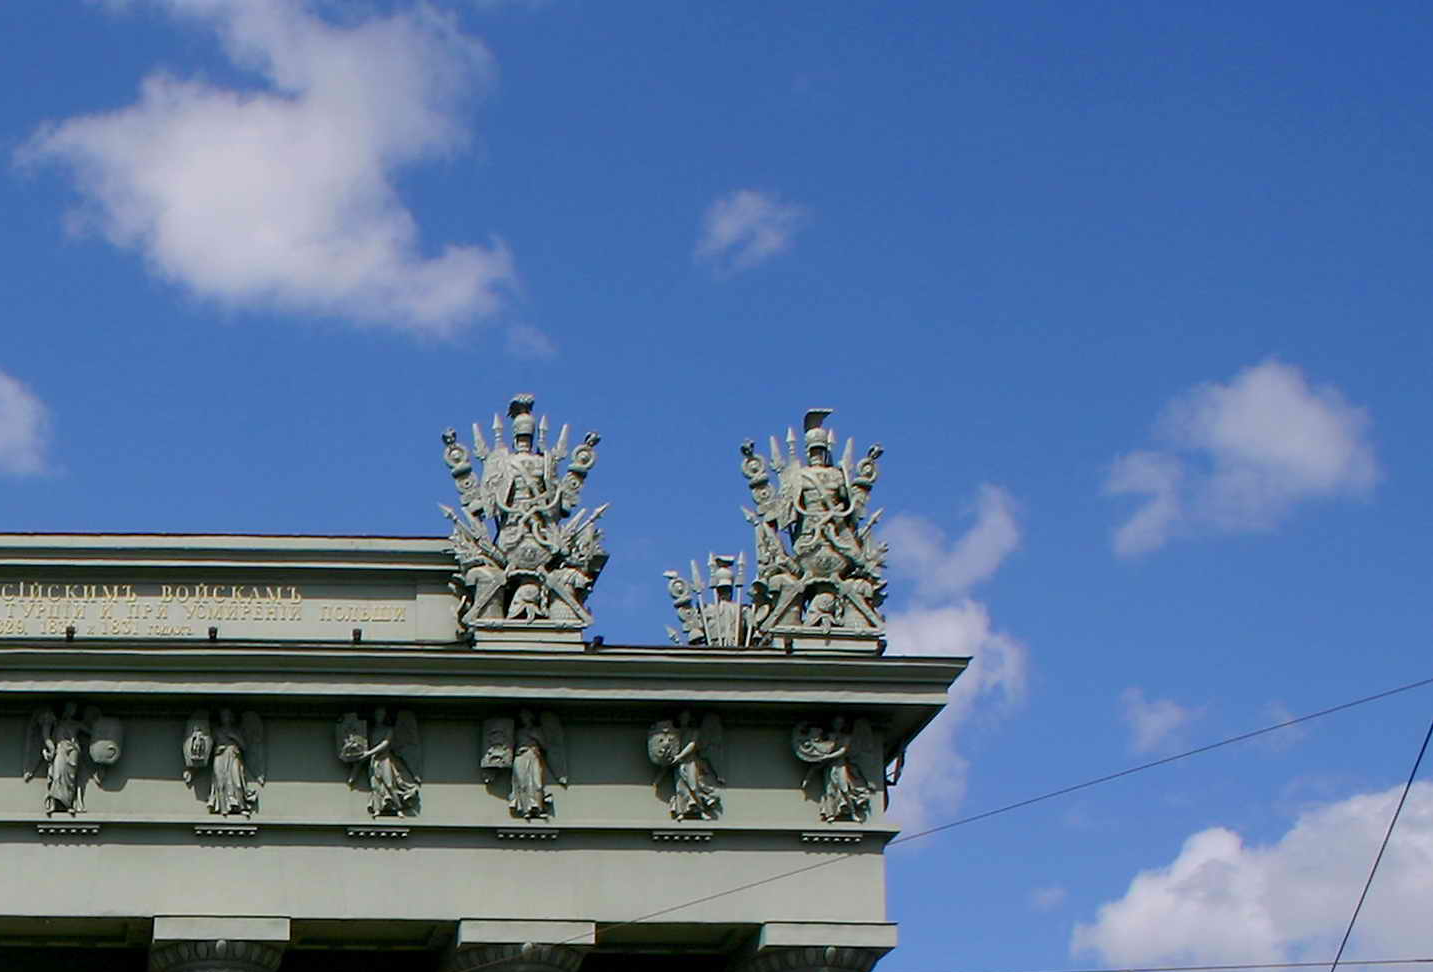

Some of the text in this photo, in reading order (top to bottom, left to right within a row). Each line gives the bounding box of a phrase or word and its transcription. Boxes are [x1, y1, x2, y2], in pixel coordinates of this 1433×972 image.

[160, 583, 303, 604] ВОЙСКАМЪ
[100, 604, 118, 619] И
[126, 604, 168, 620] ПРИ
[319, 606, 407, 622] ПОЛЬШИ
